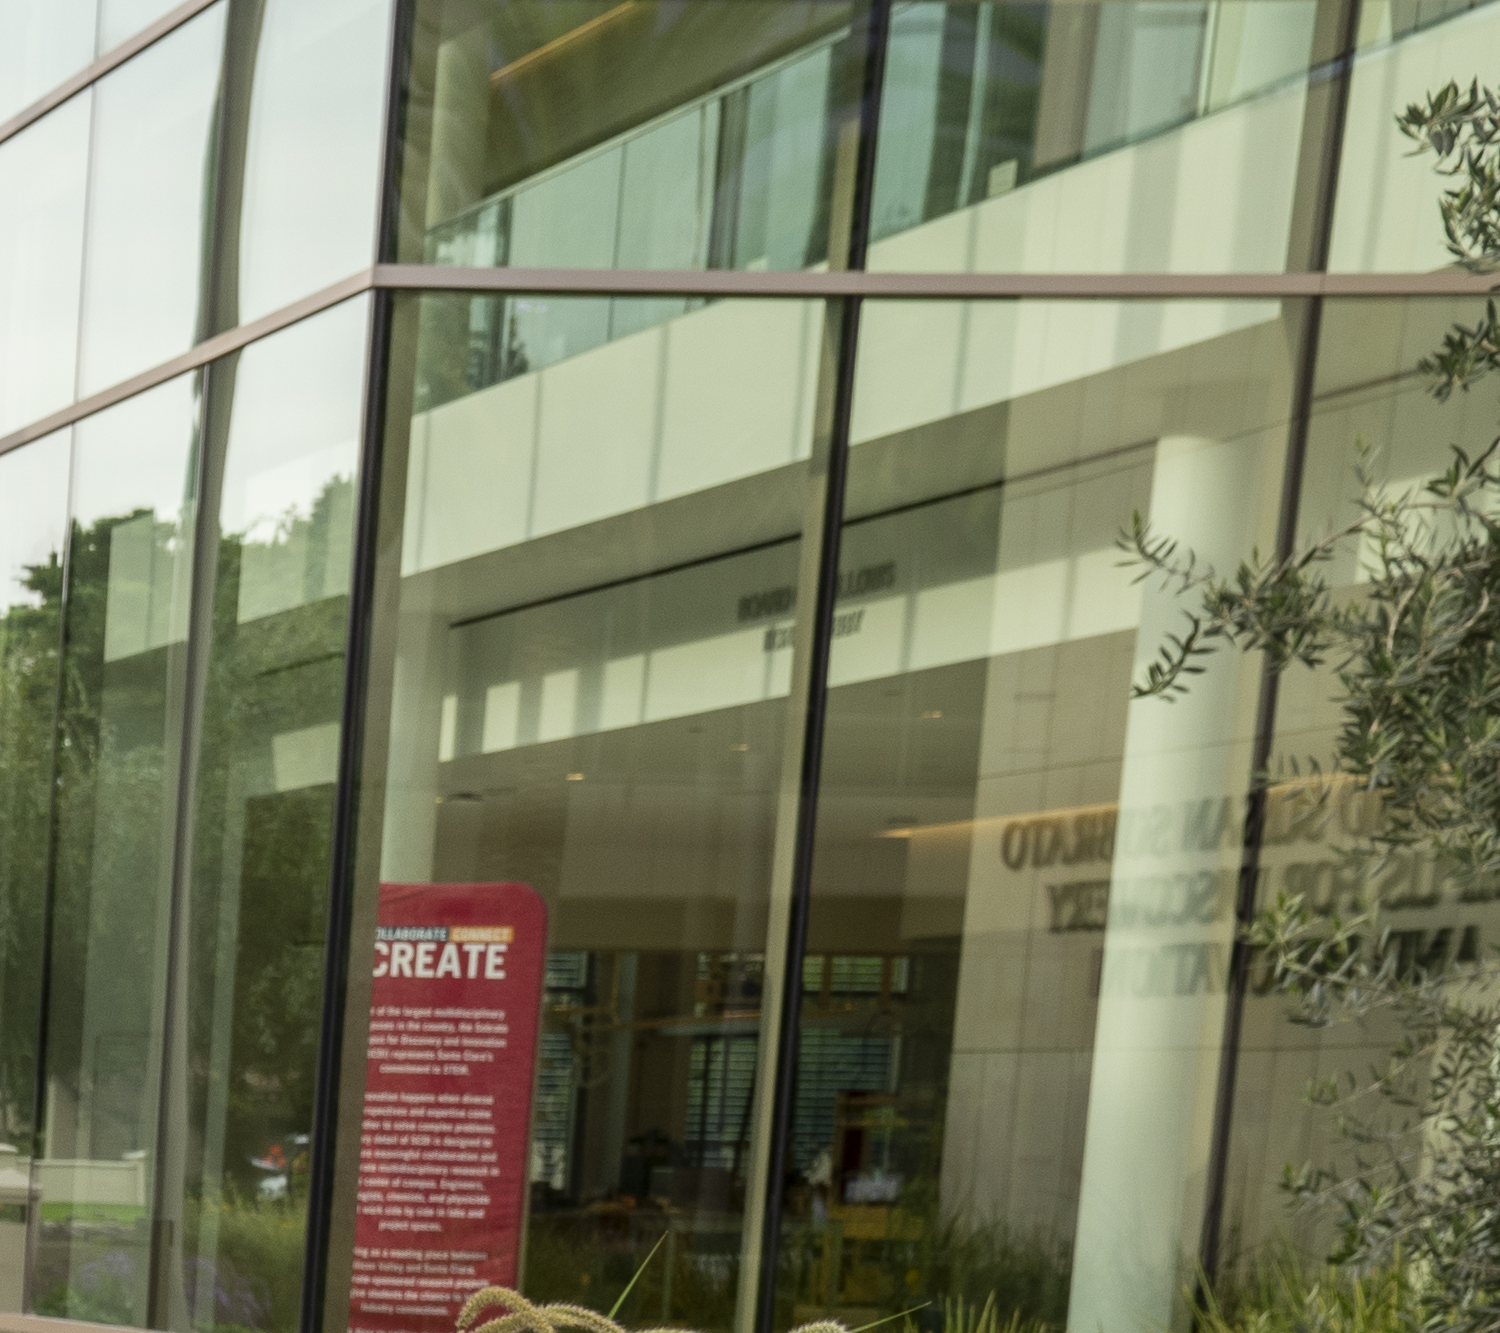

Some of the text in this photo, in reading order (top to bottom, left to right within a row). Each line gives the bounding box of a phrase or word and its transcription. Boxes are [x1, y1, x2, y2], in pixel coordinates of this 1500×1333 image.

[376, 927, 509, 942] OLLABORATE CONNECT
[372, 942, 508, 979] CREATE
